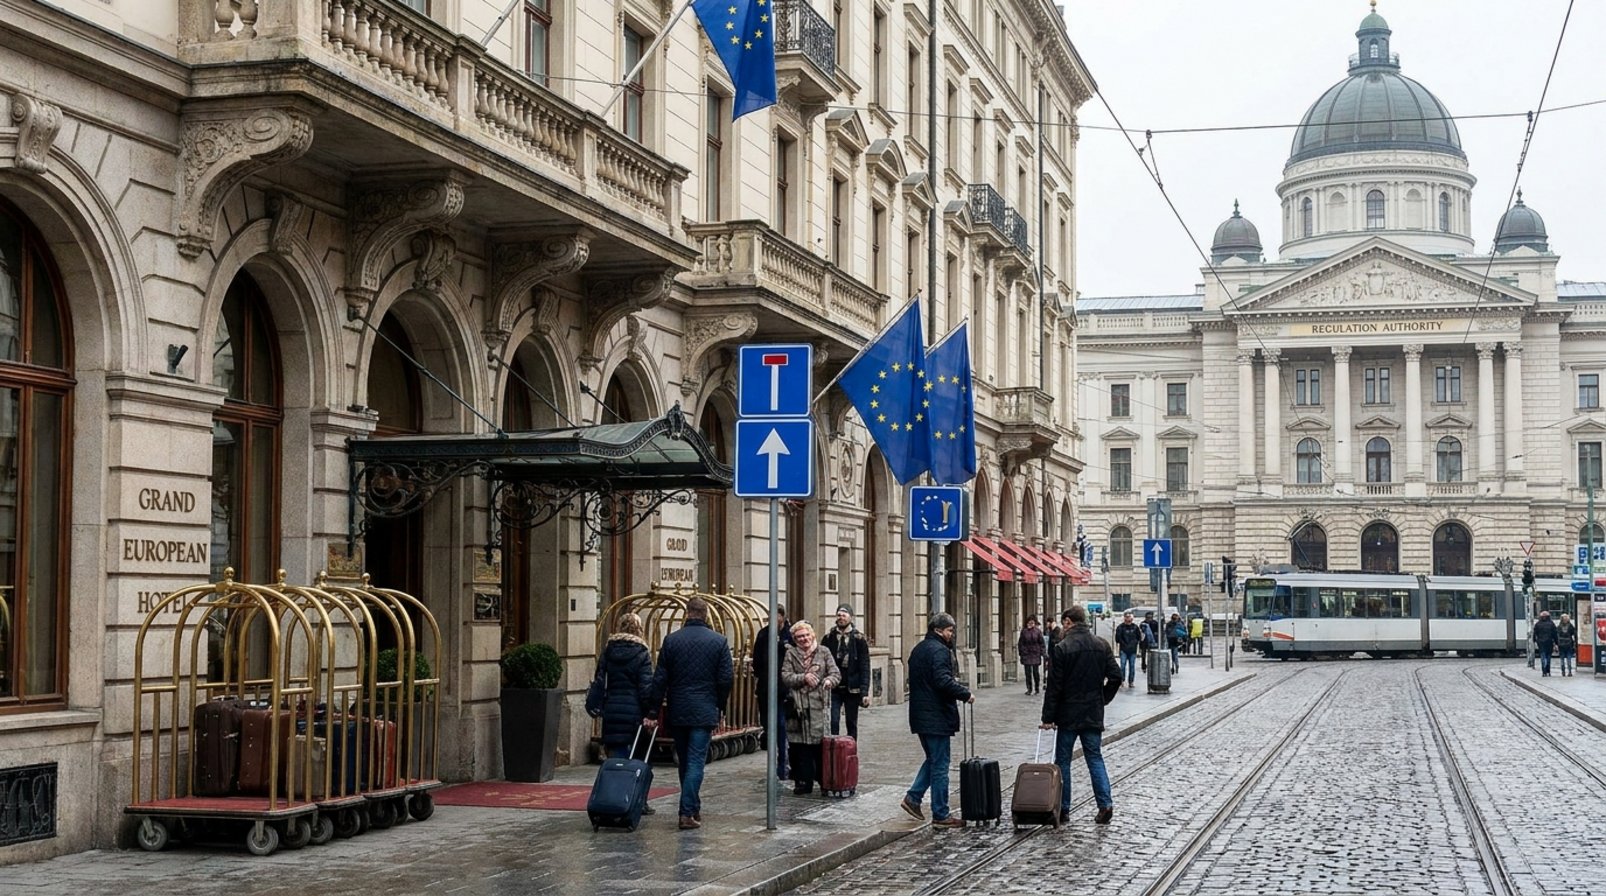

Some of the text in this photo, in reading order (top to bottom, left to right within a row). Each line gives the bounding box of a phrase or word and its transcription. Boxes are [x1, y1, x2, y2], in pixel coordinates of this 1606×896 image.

[1383, 321, 1444, 332] AUTHORITY
[138, 488, 196, 513] GRAND
[123, 538, 208, 563] EUROPEAN
